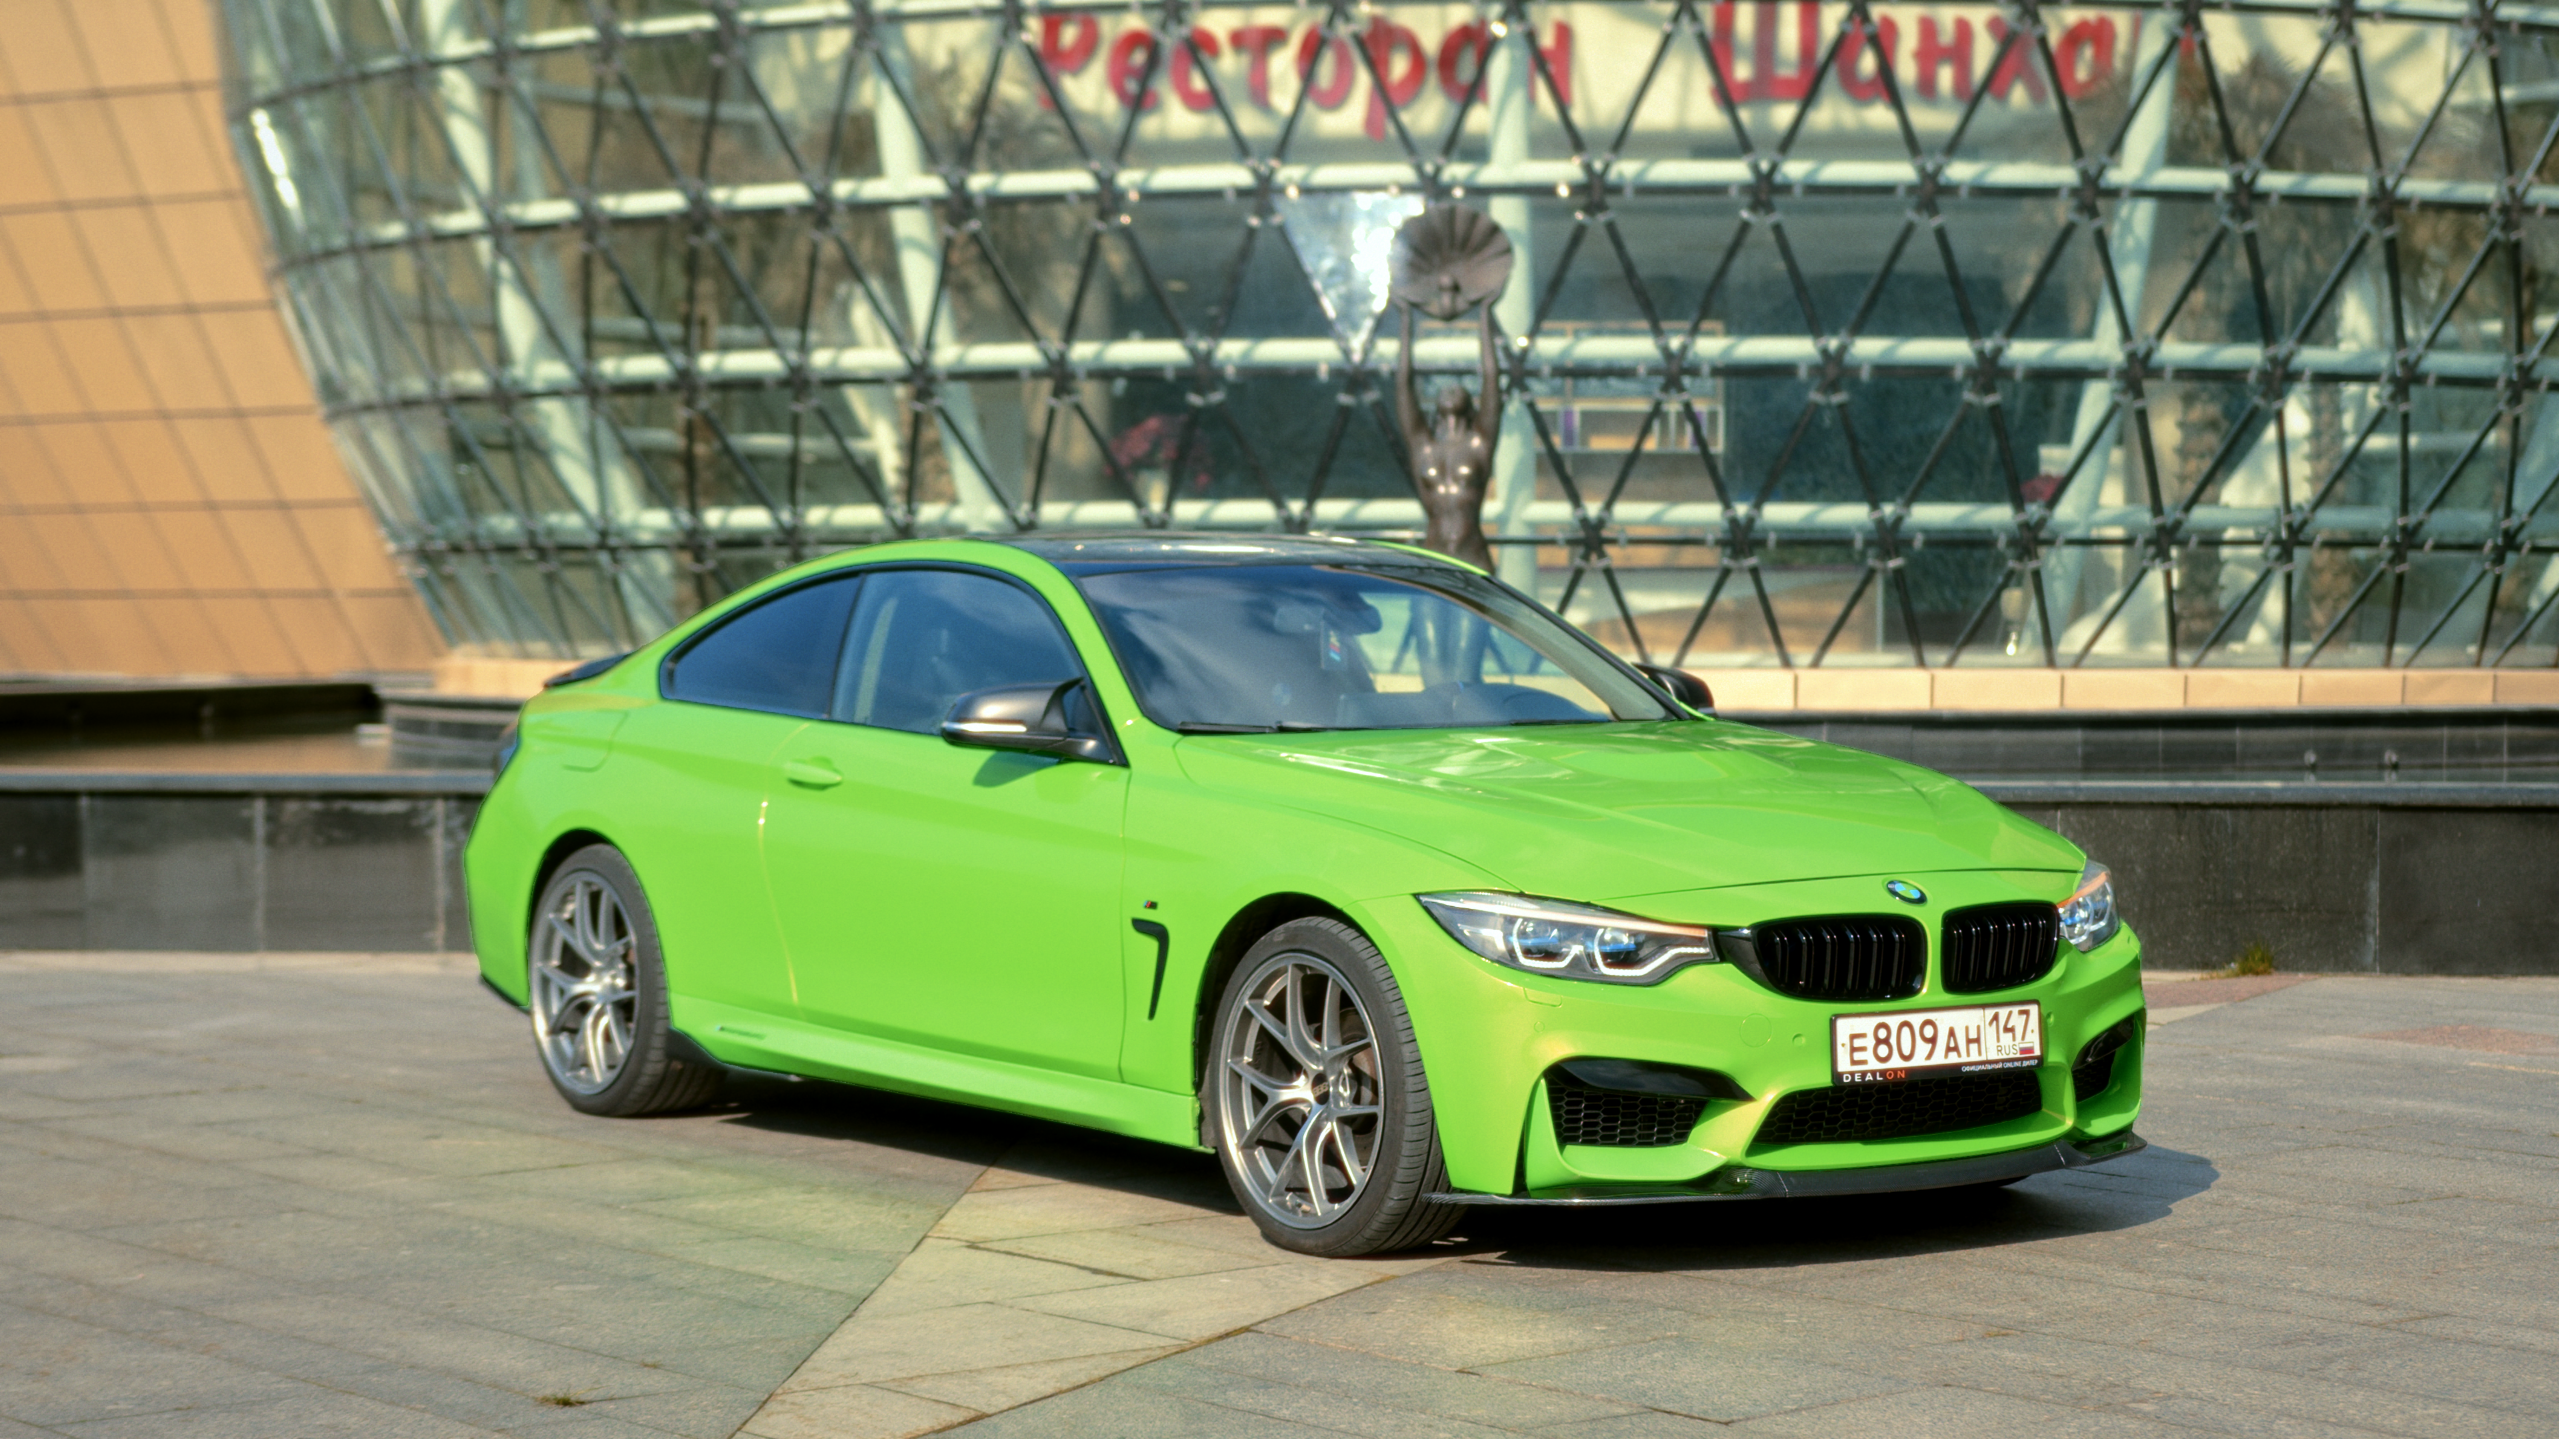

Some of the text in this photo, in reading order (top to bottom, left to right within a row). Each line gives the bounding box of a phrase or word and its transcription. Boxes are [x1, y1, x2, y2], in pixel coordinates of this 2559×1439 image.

[1037, 0, 2196, 141] Ресторан Шанха
[1849, 1008, 2031, 1067] Е809АН 147
[1996, 1043, 2019, 1057] RUS
[2003, 1060, 2021, 1069] ONLINE
